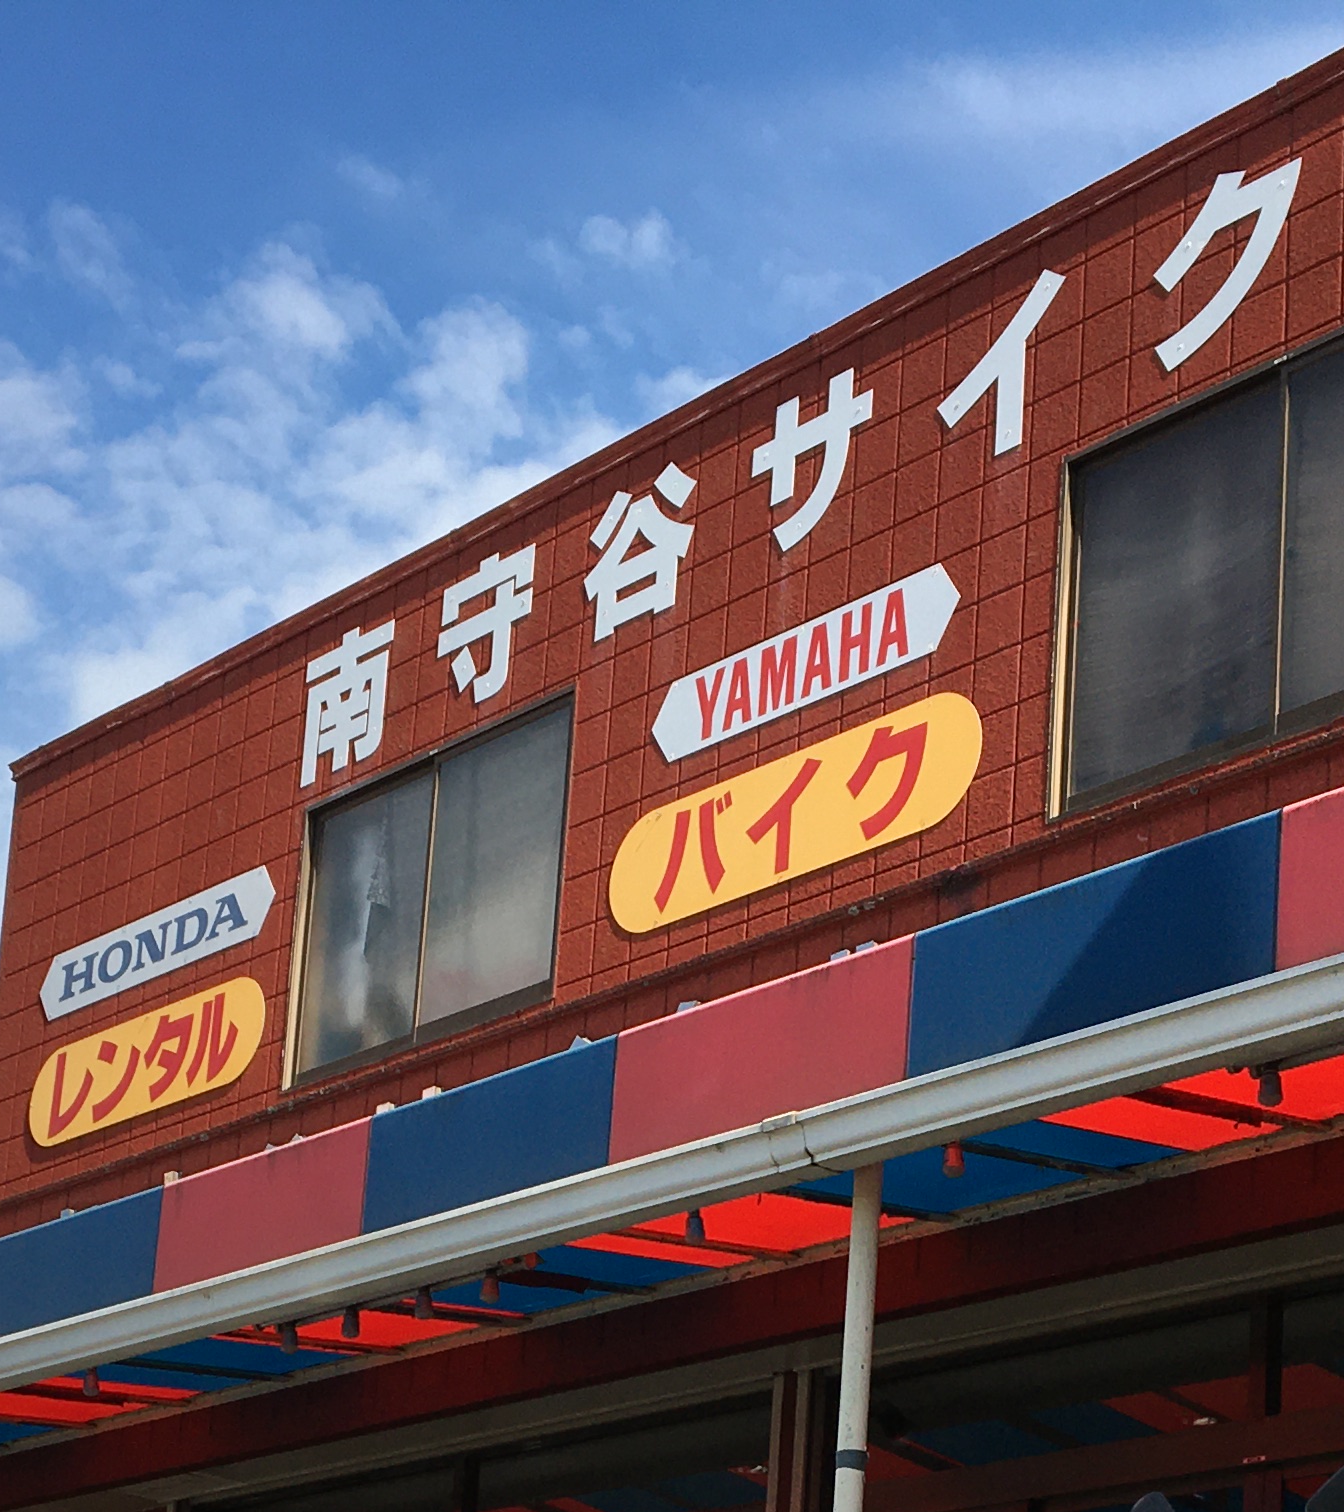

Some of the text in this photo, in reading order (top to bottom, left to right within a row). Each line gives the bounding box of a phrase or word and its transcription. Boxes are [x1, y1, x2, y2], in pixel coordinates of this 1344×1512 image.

[696, 587, 911, 742] YAMAHA
[654, 721, 929, 914] バイク
[57, 892, 249, 1004] HONDA
[48, 992, 239, 1138] レンタル
